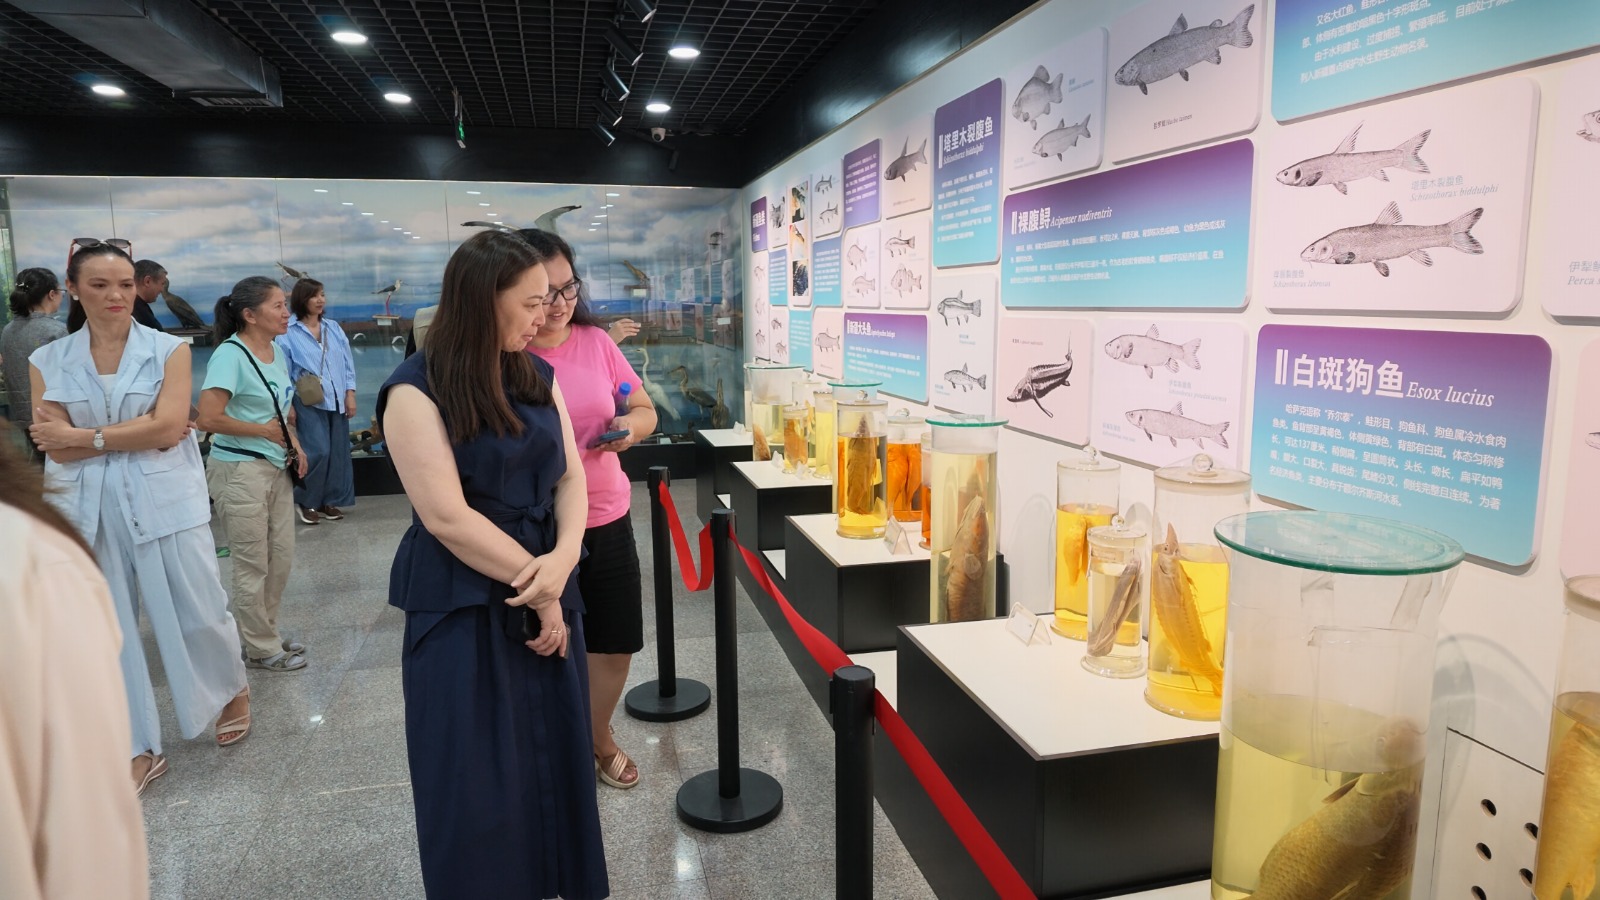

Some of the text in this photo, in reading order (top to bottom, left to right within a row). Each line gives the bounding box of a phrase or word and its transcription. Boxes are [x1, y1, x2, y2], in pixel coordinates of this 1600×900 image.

[943, 116, 993, 153] 塔里木裂腹鱼
[1459, 183, 1499, 196] biddulphi
[1018, 207, 1050, 233] 裸腹鲟
[1567, 275, 1594, 286] Perca
[1293, 353, 1495, 407] 白斑狗鱼 Esox lucius
